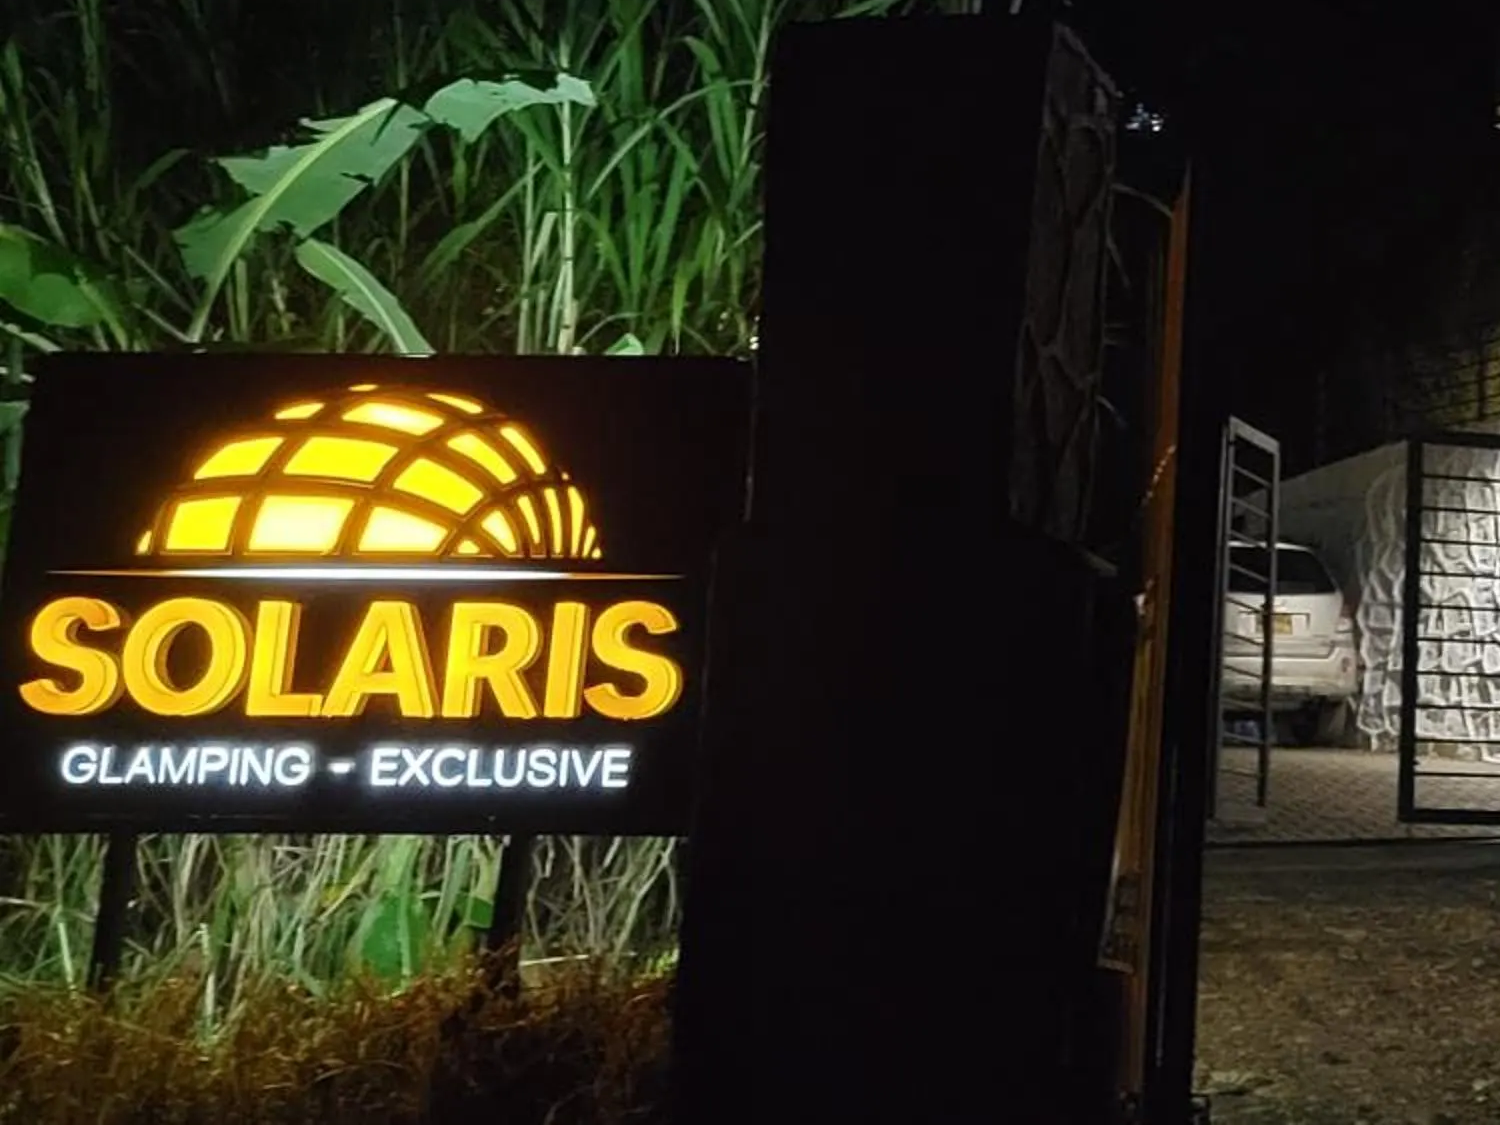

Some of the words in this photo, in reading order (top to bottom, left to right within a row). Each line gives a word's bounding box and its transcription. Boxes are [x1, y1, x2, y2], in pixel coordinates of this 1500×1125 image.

[19, 597, 684, 720] SOLARIS
[61, 745, 313, 787] GLAMPING
[369, 748, 632, 789] EXCLUSIVE
